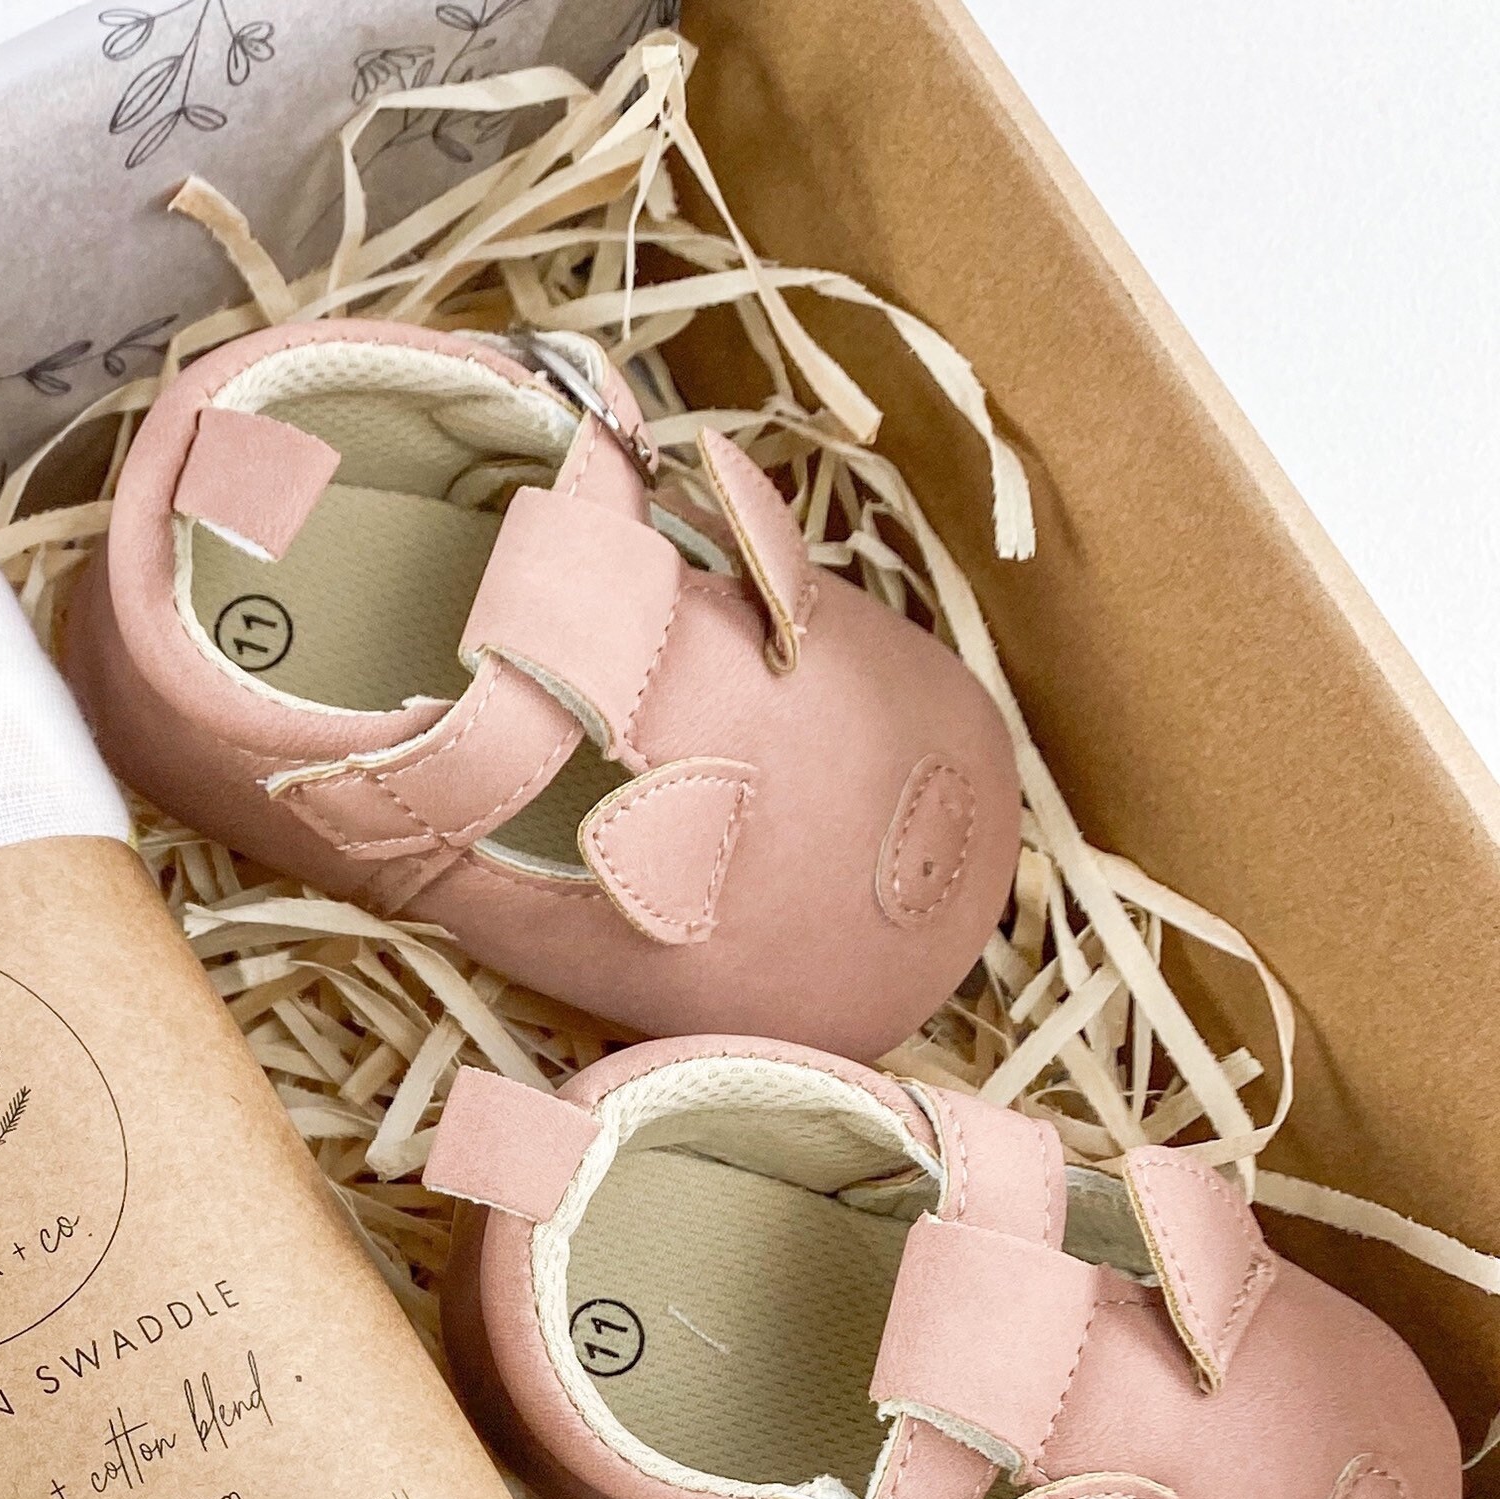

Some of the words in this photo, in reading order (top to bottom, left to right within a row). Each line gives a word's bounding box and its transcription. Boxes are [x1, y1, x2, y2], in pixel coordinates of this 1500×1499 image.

[232, 613, 278, 656] 11
[11, 1241, 26, 1261] +
[35, 1279, 241, 1395] SWADDLE
[583, 1316, 629, 1360] 11
[90, 1406, 177, 1493] cotton
[183, 1349, 274, 1453] blend
